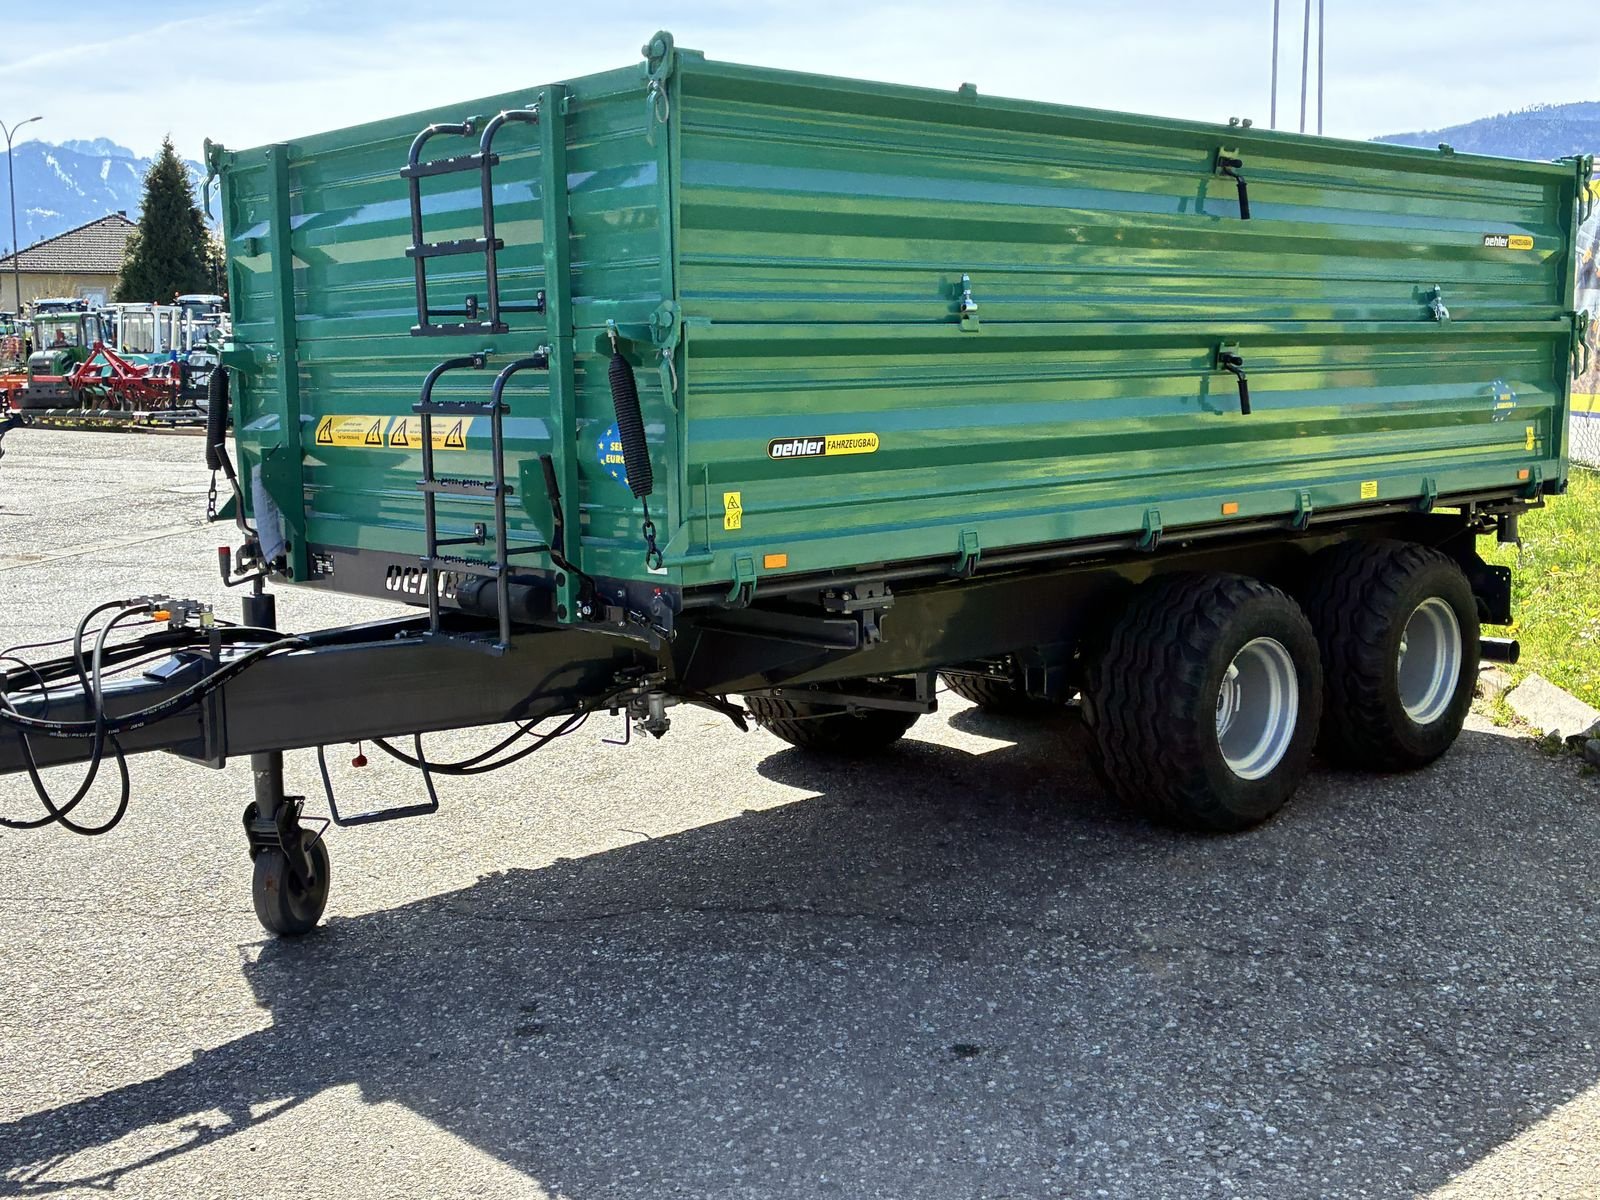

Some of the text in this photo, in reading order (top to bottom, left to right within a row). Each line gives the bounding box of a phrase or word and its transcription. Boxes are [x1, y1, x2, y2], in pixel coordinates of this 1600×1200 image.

[1485, 236, 1508, 246] oehler
[772, 438, 876, 456] oehler FAHRZEUGBAU
